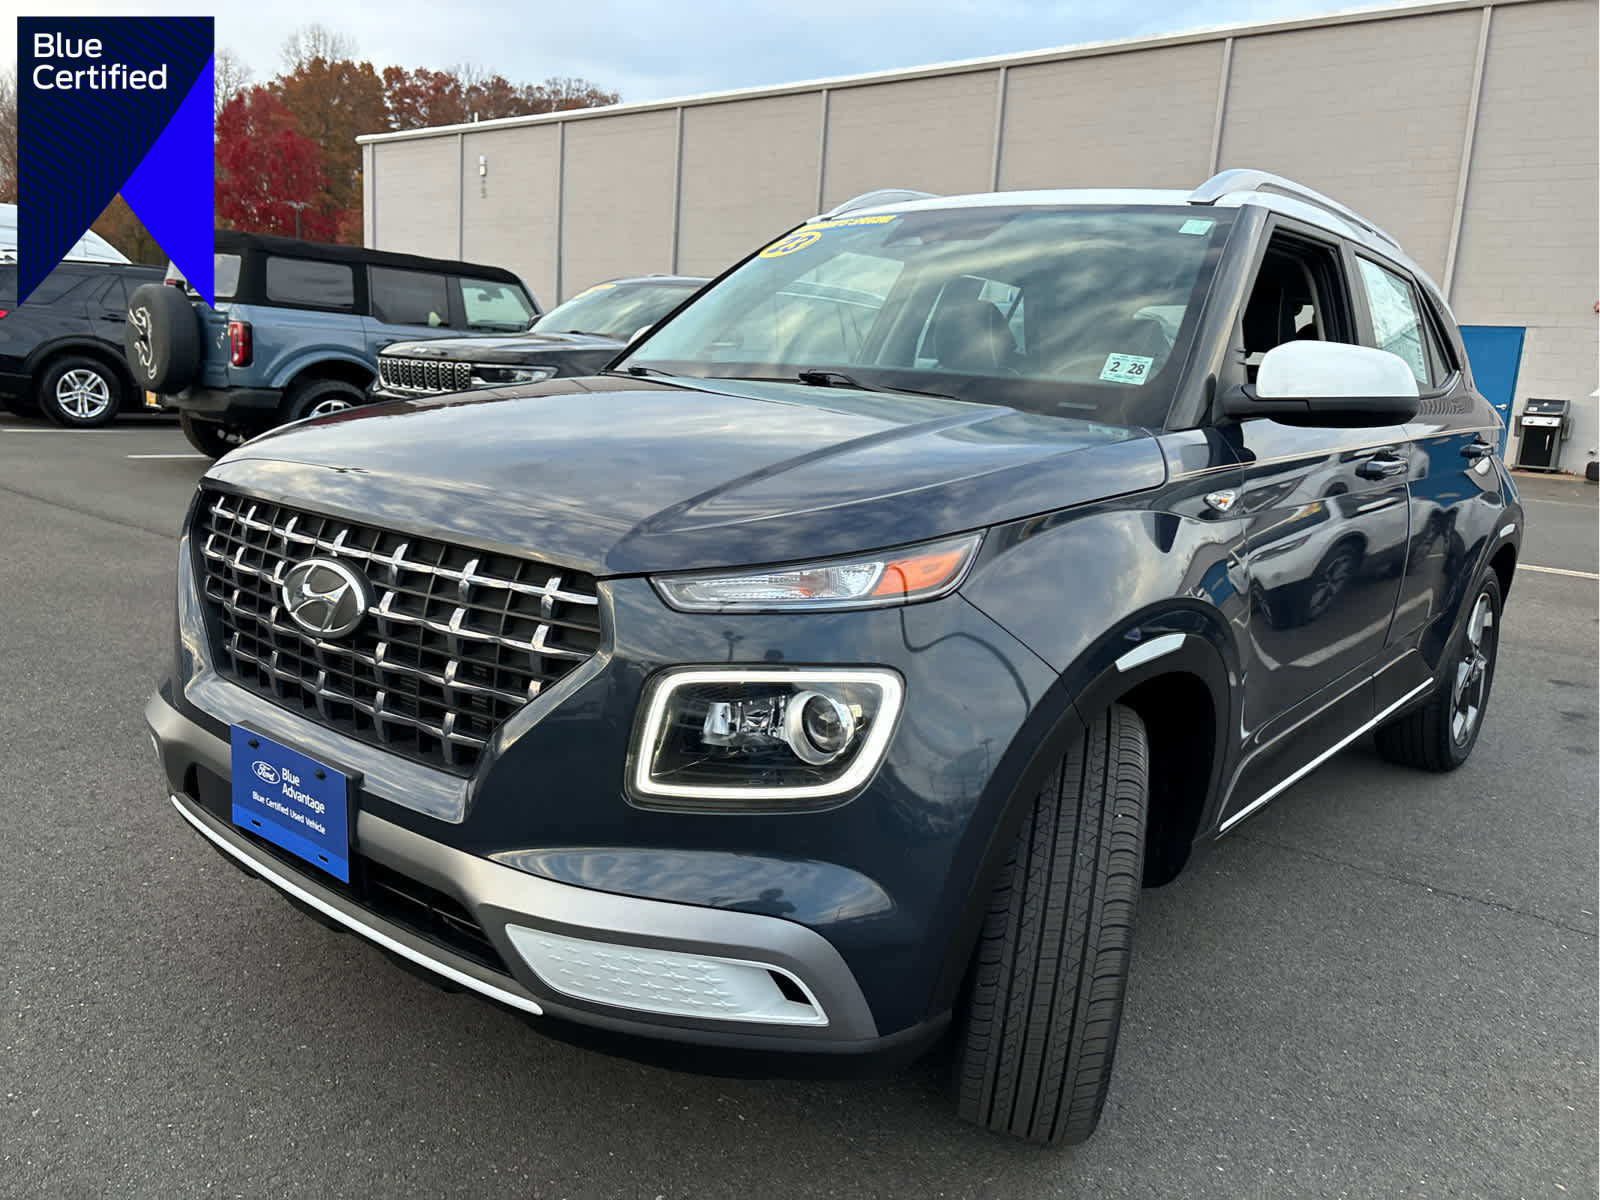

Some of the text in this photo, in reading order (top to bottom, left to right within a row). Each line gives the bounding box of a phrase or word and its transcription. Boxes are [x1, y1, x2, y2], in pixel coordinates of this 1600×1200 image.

[1110, 361, 1145, 375] 2 28
[255, 762, 277, 783] Ford
[282, 767, 300, 786] Blue
[282, 783, 325, 814] Advantage
[252, 790, 326, 834] Blue Certified Used Vehicle
